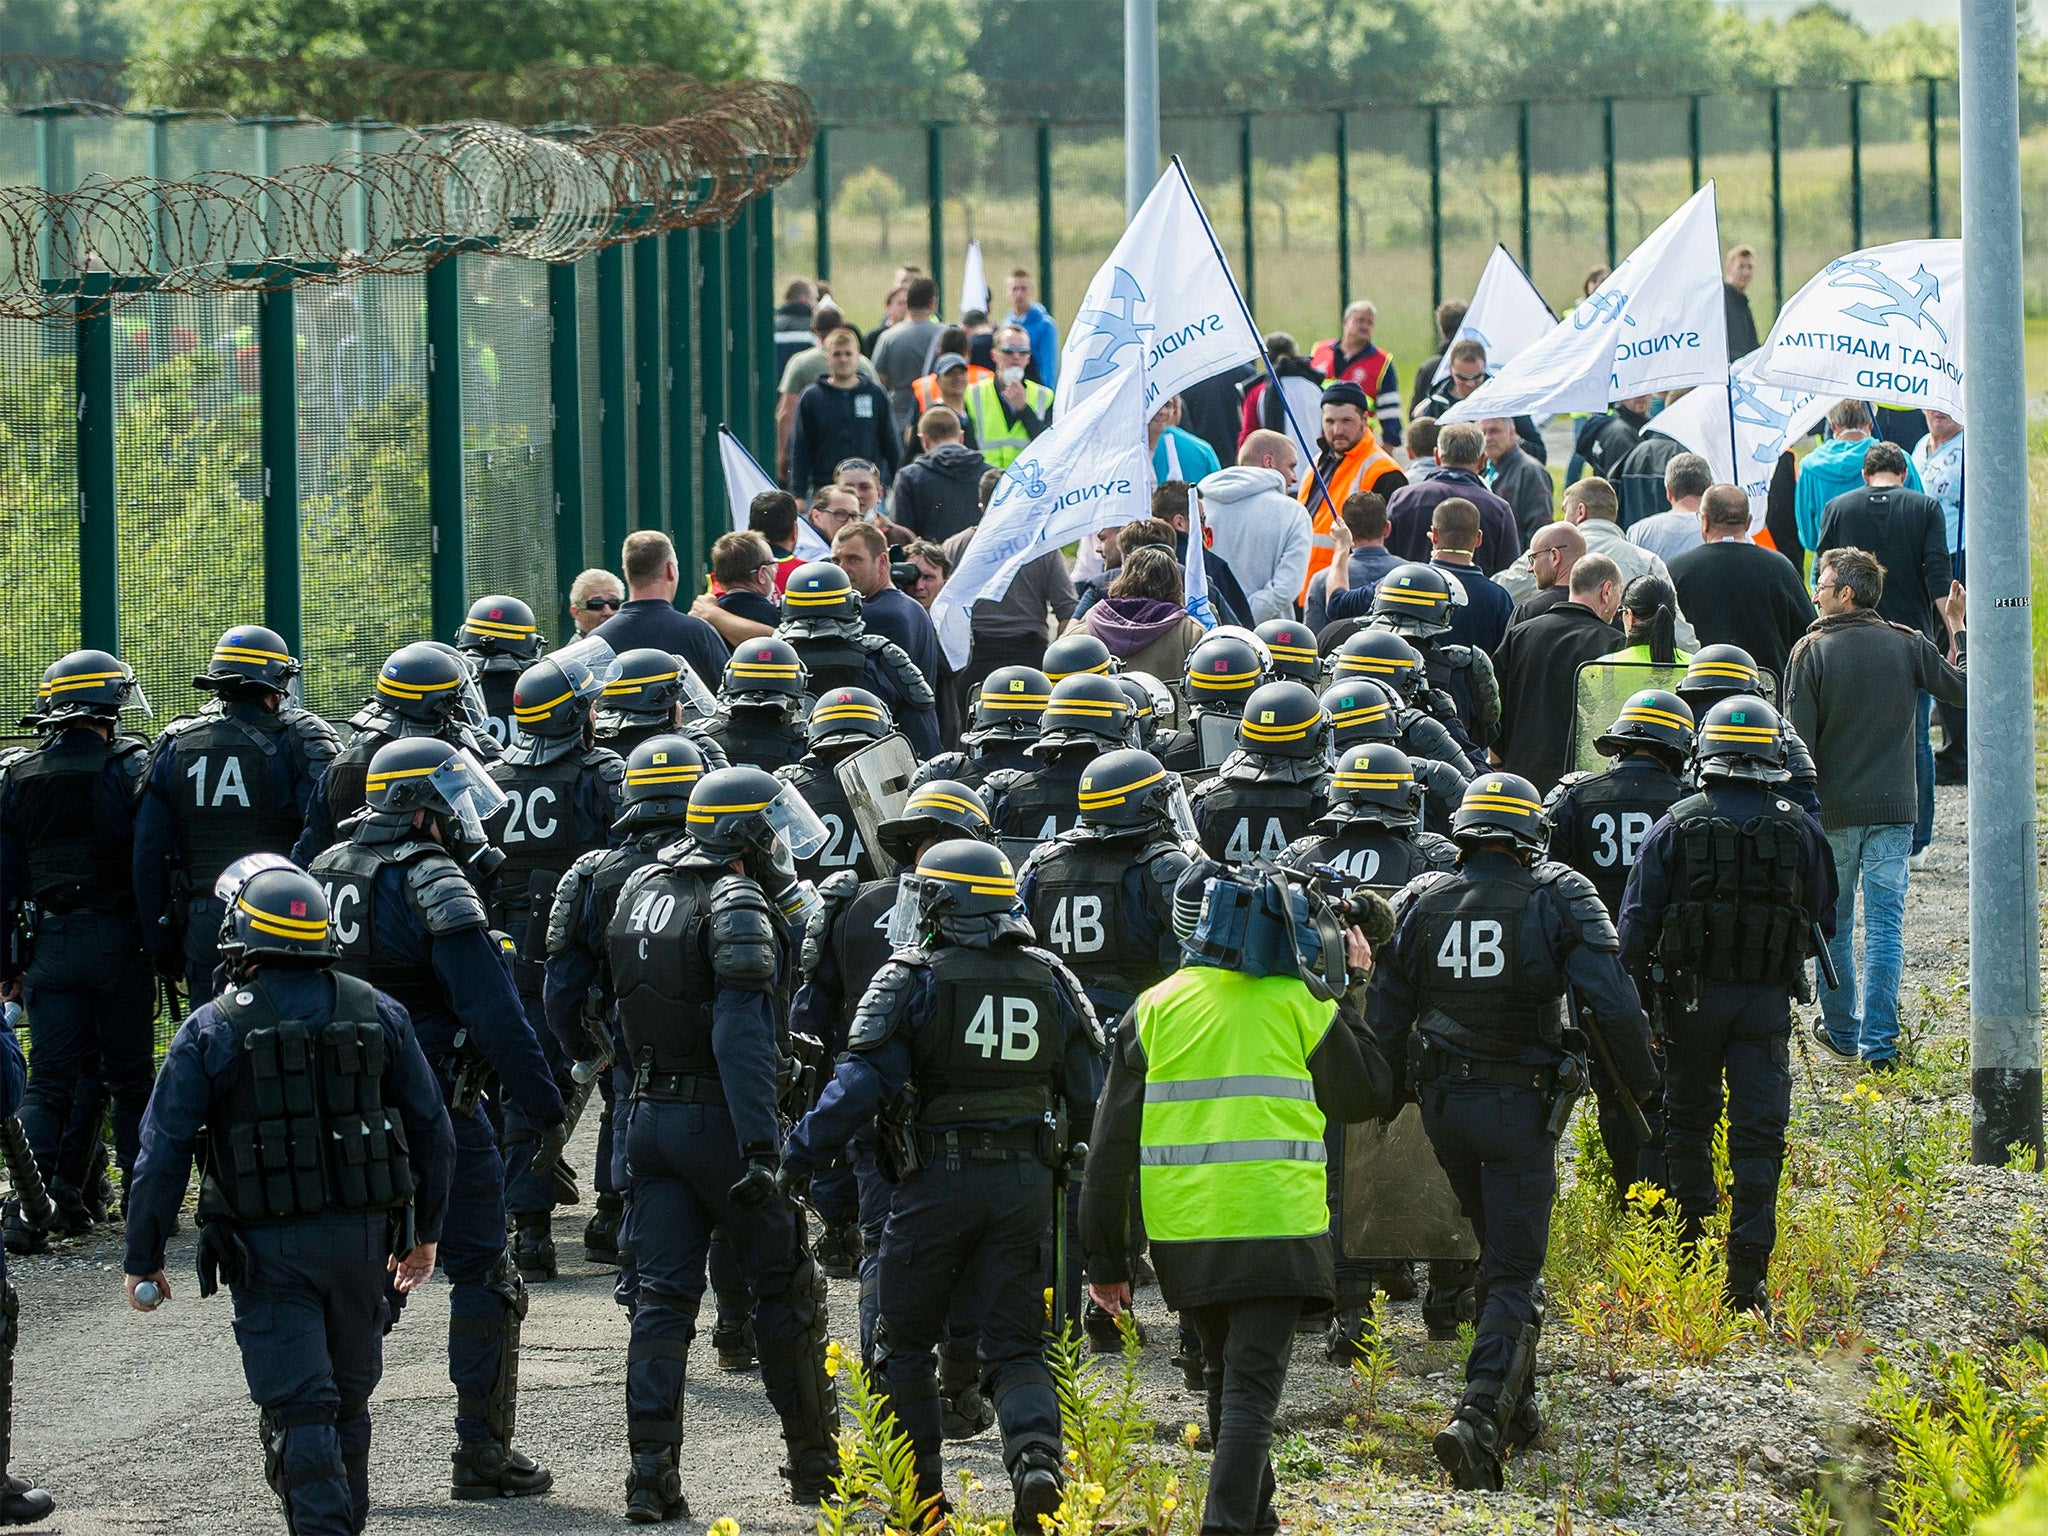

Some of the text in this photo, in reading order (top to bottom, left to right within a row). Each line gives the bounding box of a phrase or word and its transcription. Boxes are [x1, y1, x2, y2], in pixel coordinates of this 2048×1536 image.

[186, 756, 251, 807] 1A
[503, 786, 558, 844] 2C
[1592, 812, 1653, 867] 3B
[630, 890, 676, 934] 40
[1050, 895, 1105, 954] 4B
[1437, 920, 1505, 979] 4B
[964, 994, 1040, 1061] 4B
